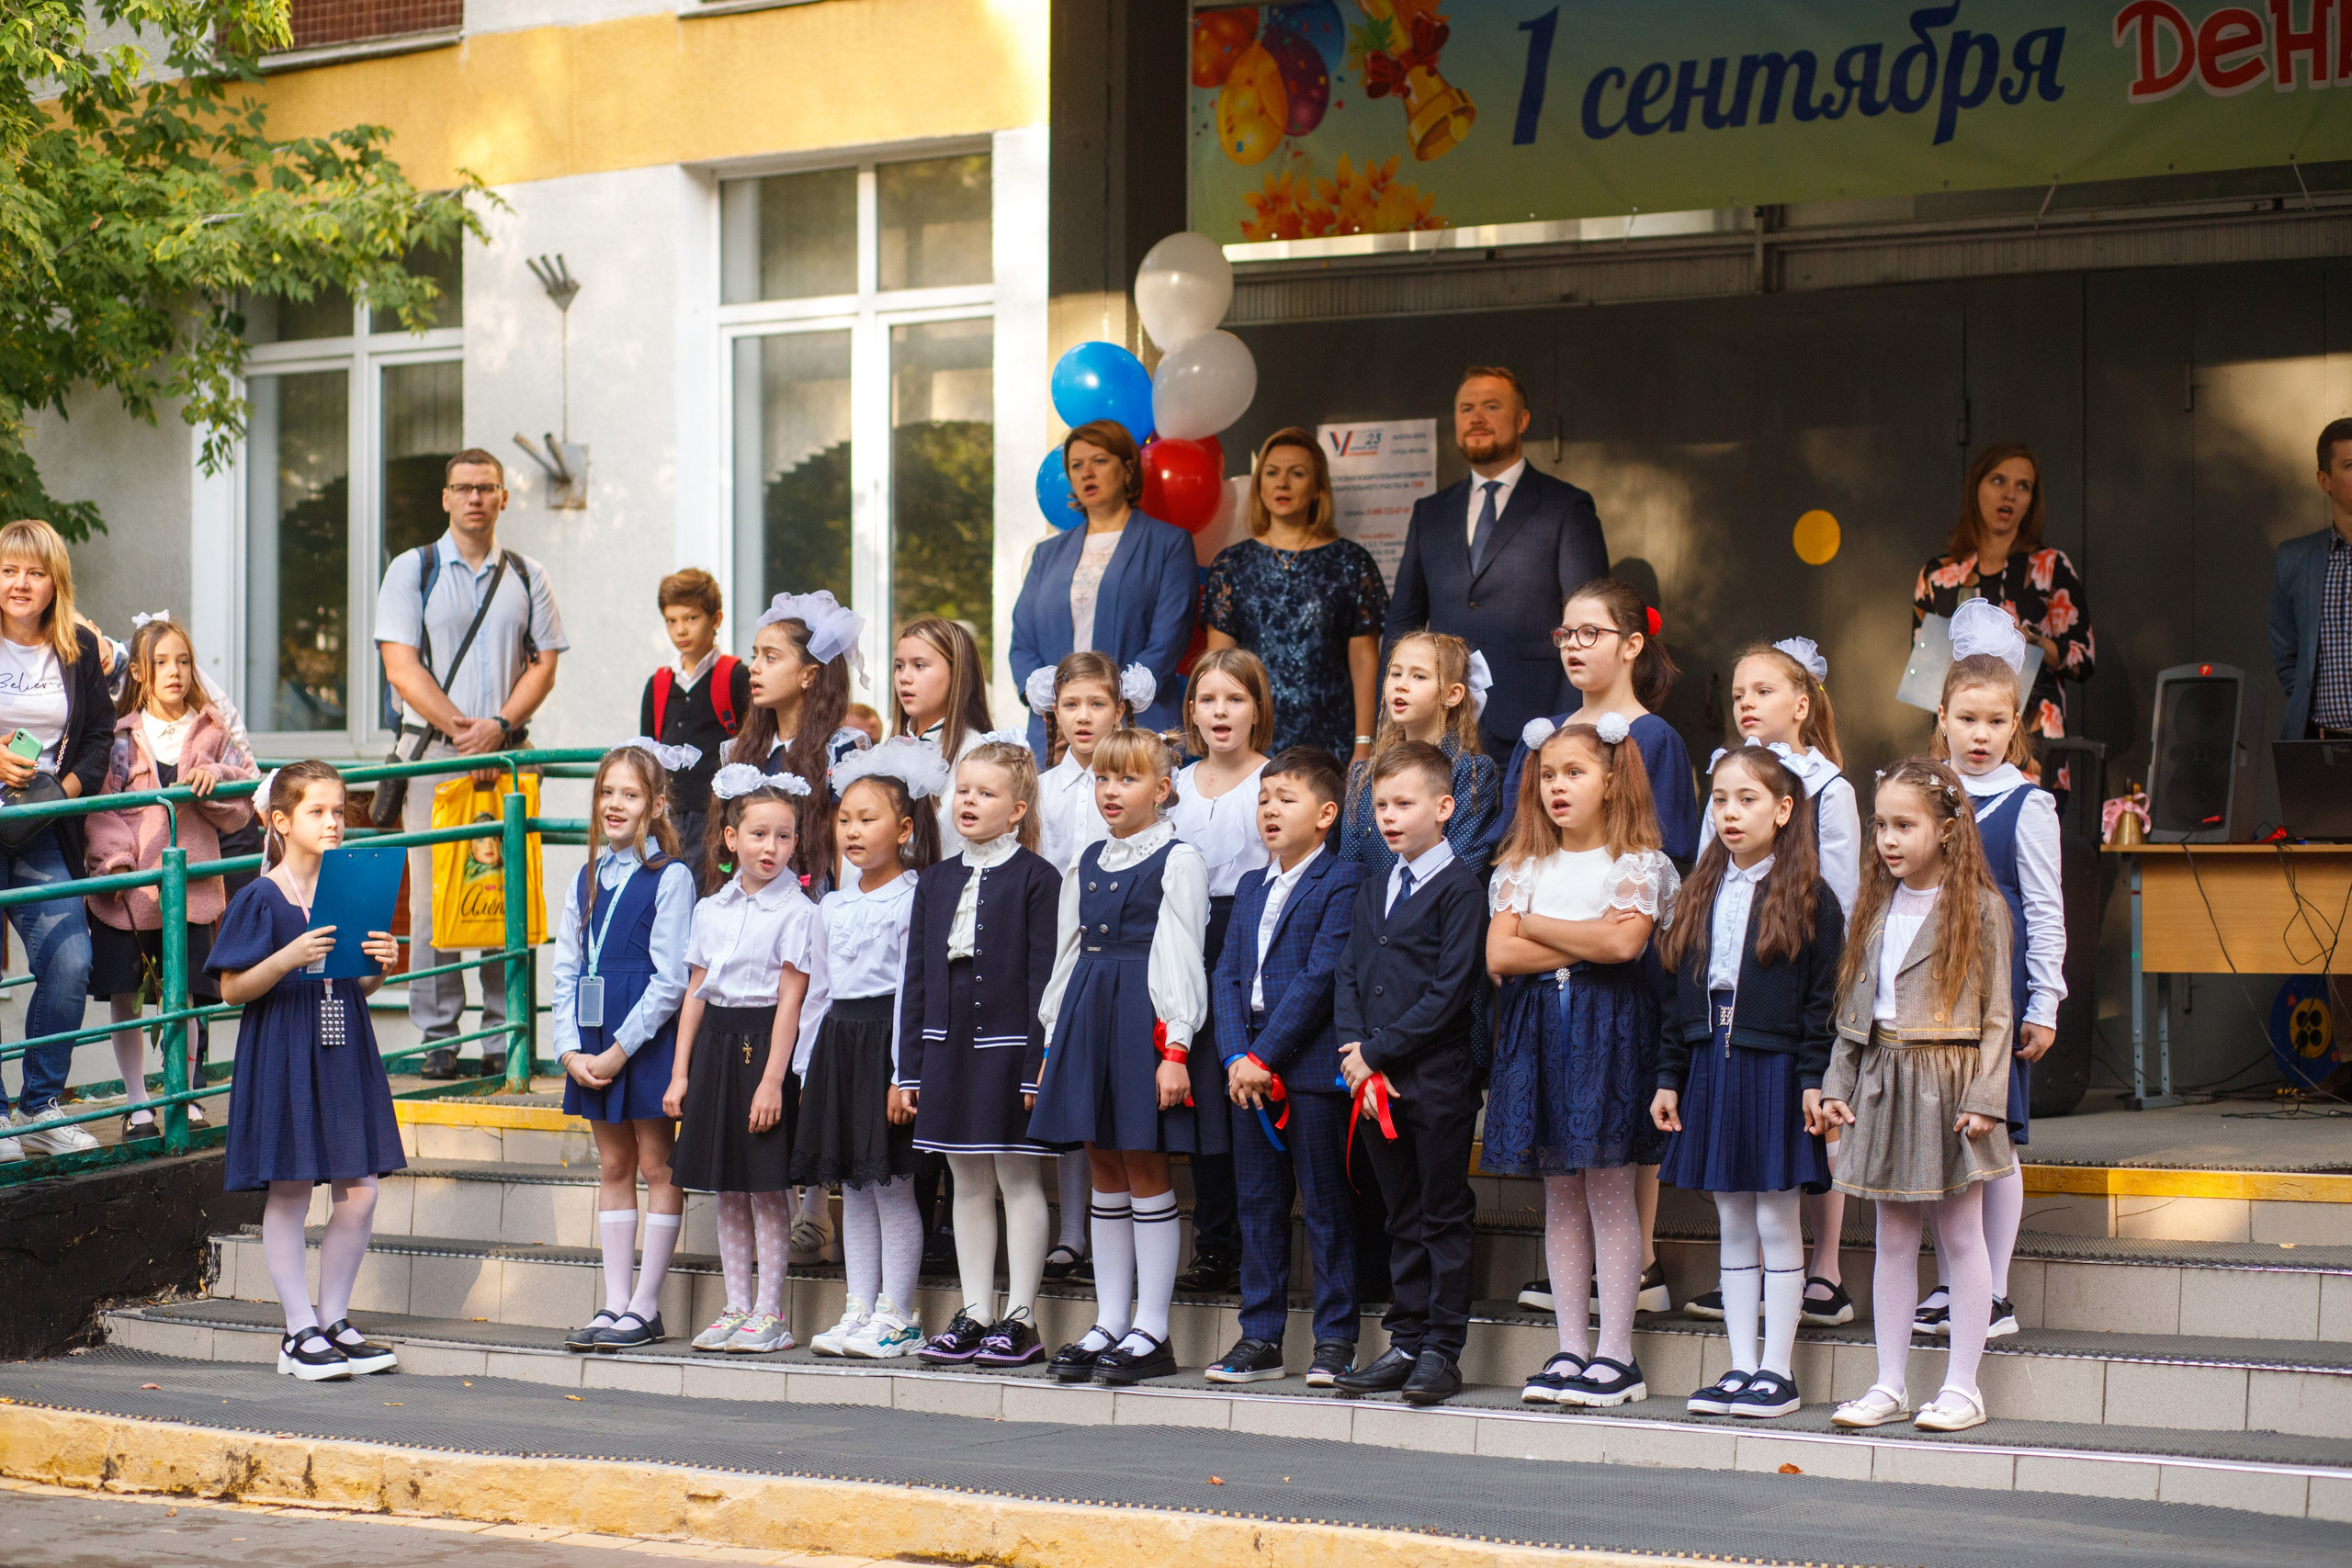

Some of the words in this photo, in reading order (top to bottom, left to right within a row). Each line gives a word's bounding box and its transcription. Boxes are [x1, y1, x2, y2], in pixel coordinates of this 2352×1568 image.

[1511, 5, 1561, 146] 1
[1581, 0, 2067, 146] сентября
[461, 884, 505, 918] Алён
